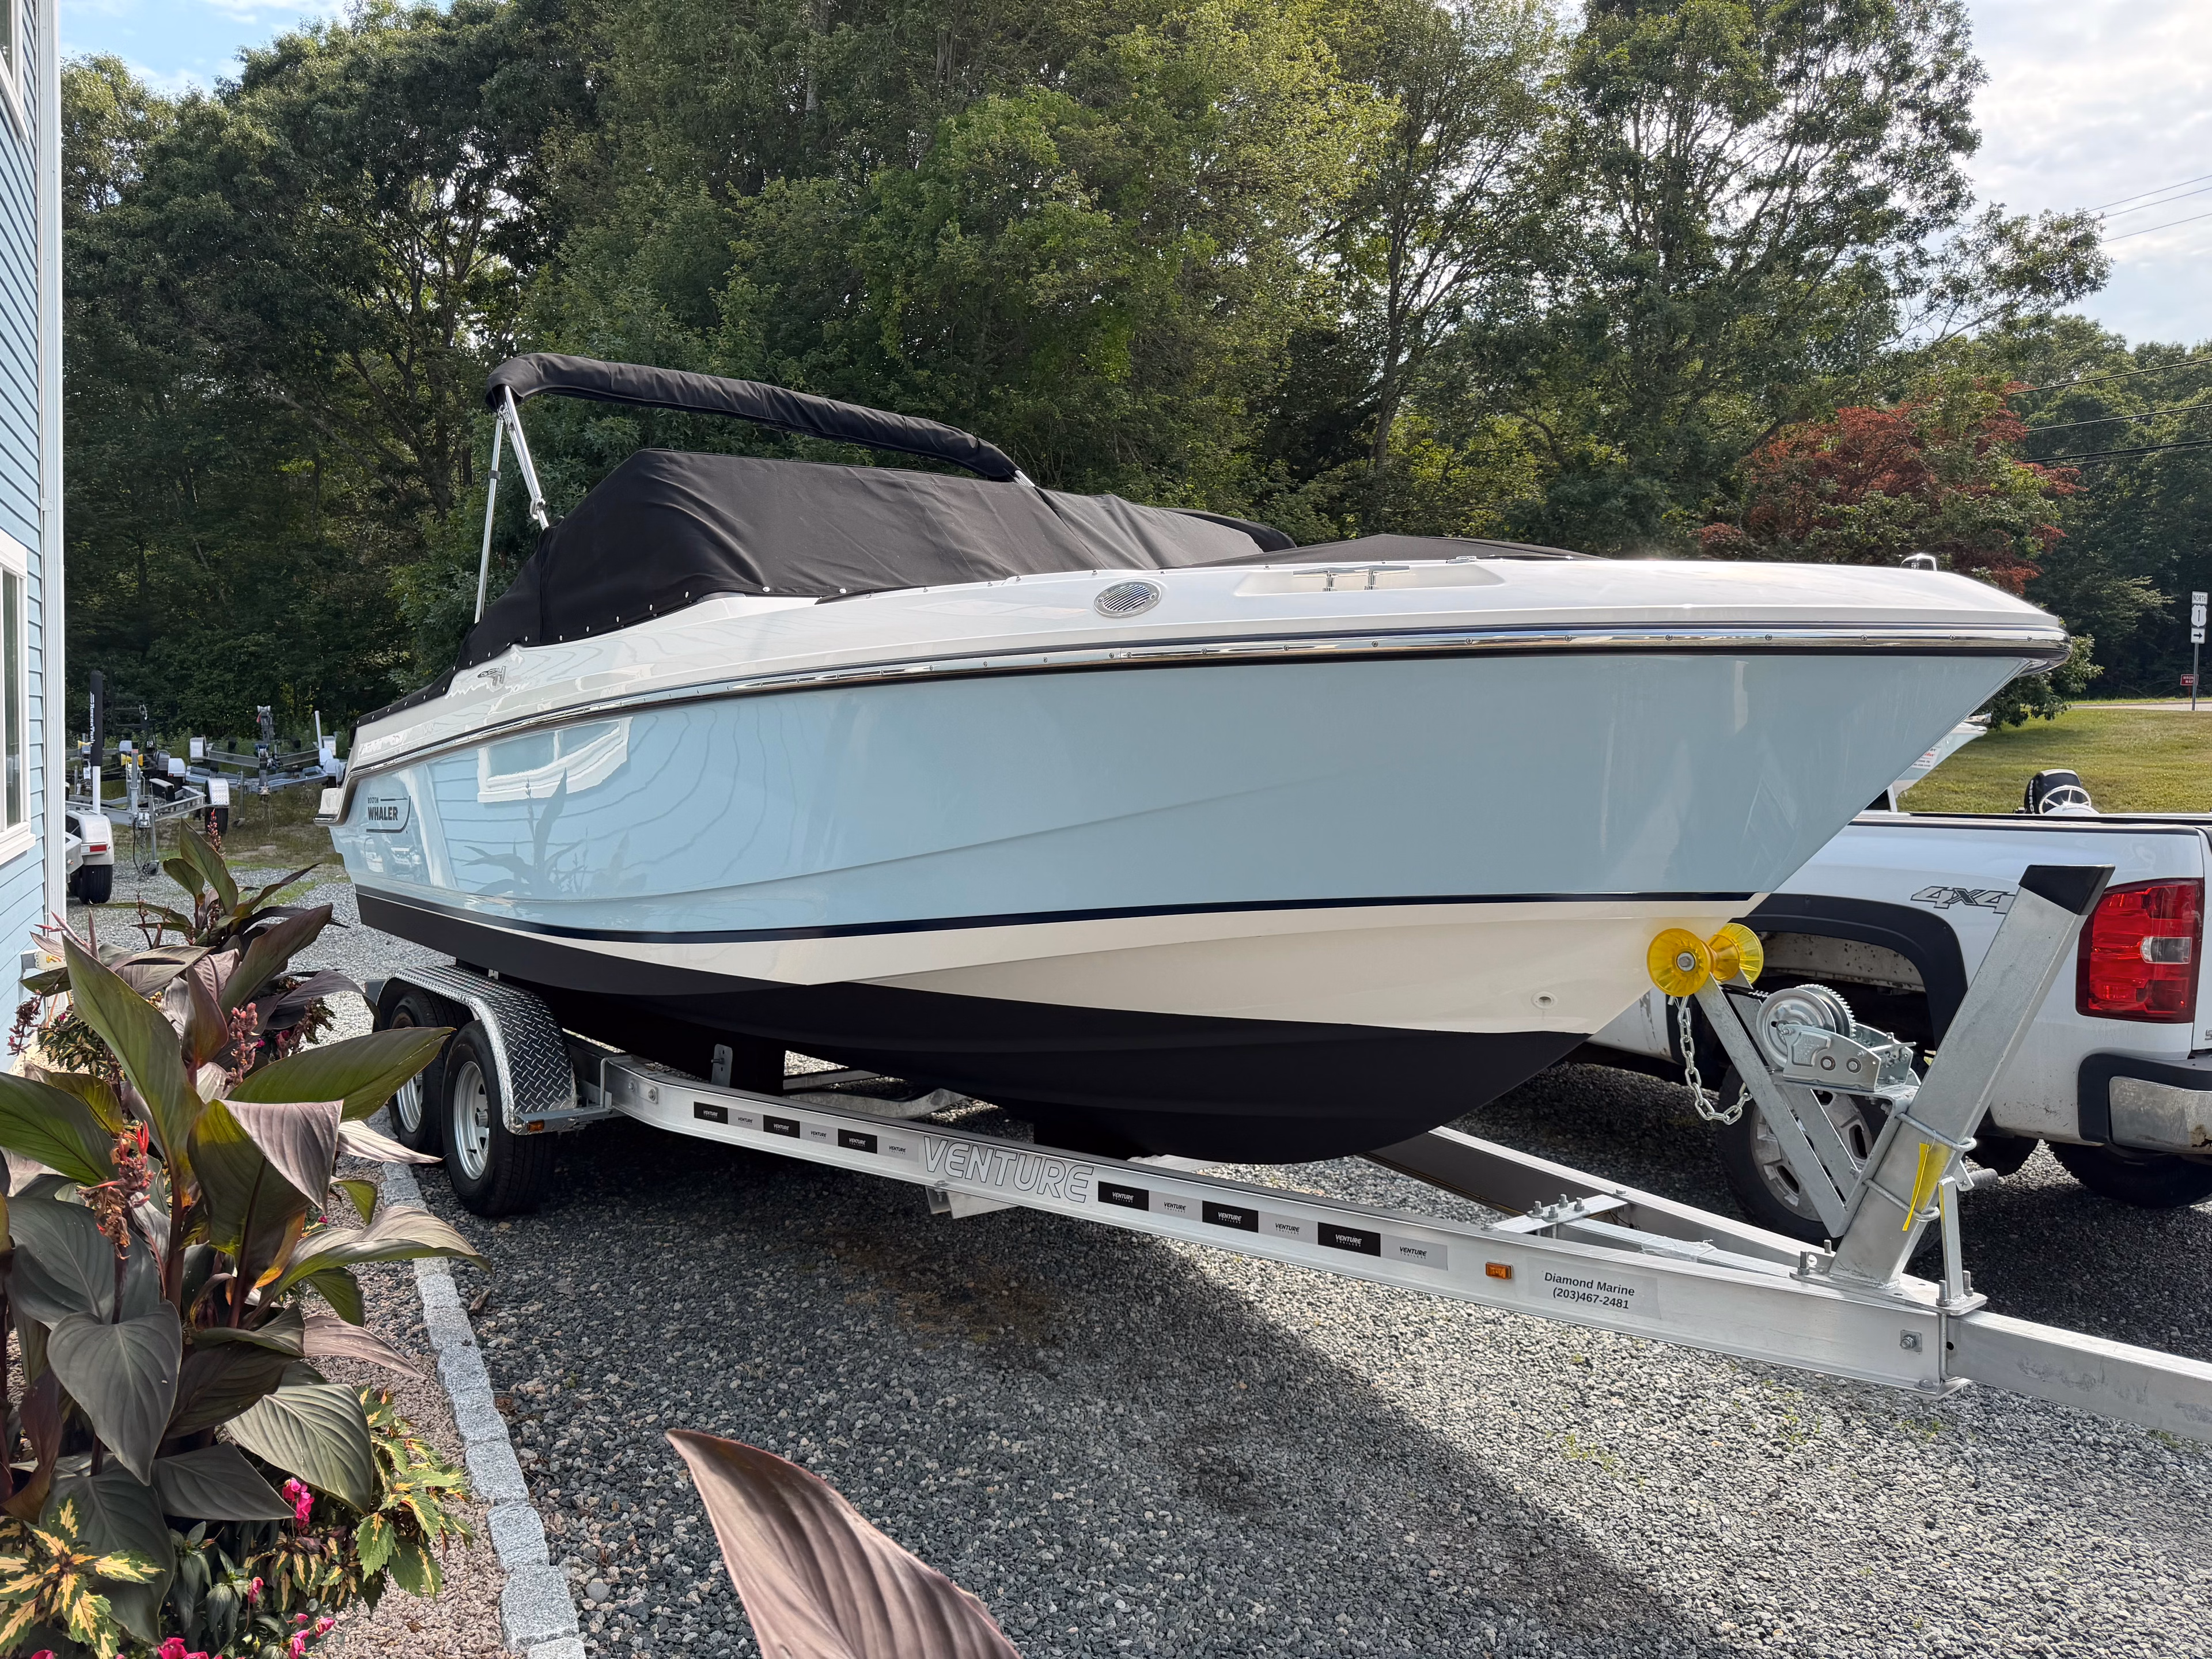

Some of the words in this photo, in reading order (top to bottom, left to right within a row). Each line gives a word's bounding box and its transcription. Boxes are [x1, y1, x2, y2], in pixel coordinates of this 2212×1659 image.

[2198, 609, 2200, 622] 1
[368, 806, 399, 821] WHALER
[924, 1136, 1094, 1203] VENTURE
[1112, 1192, 1134, 1200] VENTURE
[1164, 1202, 1186, 1210] VENTURE
[1218, 1212, 1242, 1221] VENTURE
[1275, 1223, 1300, 1232] VENTURE
[1335, 1234, 1362, 1244] VENTURE
[1400, 1247, 1427, 1256] VENTURE
[1544, 1272, 1593, 1289] Diamond
[1597, 1282, 1635, 1296] Marine
[1553, 1287, 1629, 1309] (203)467-2481
